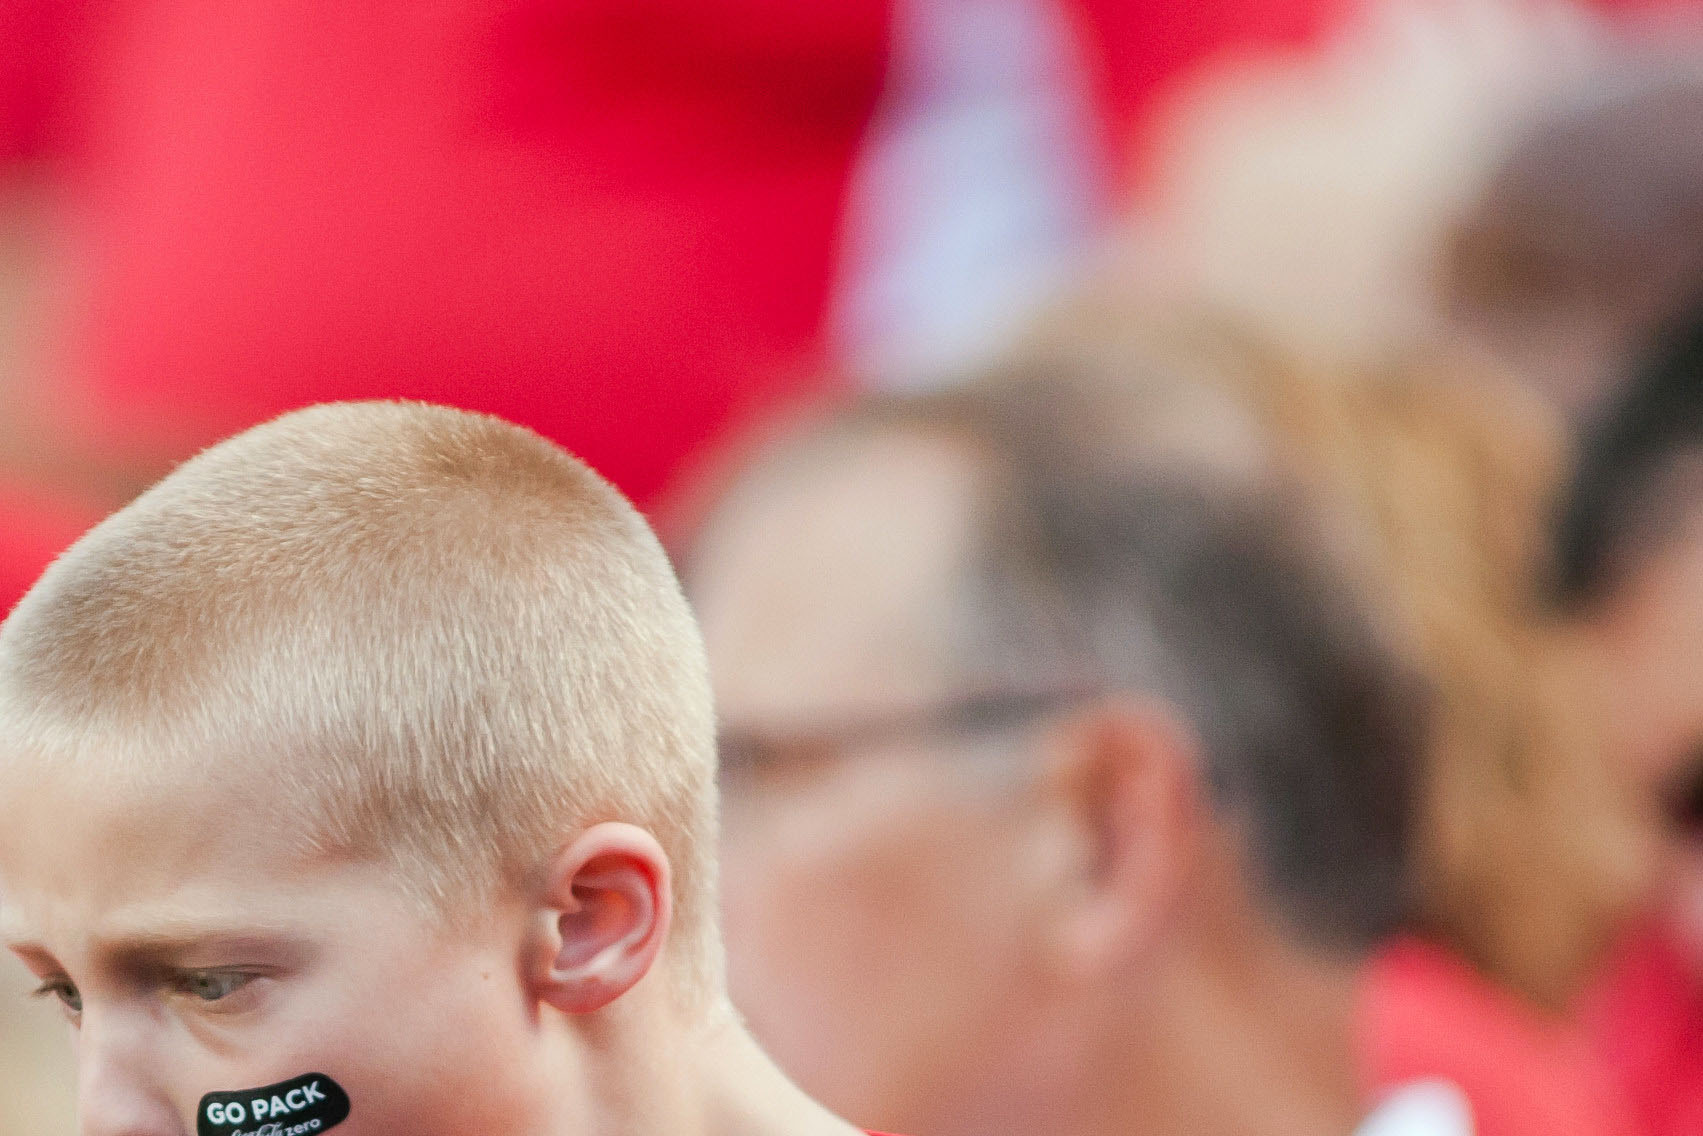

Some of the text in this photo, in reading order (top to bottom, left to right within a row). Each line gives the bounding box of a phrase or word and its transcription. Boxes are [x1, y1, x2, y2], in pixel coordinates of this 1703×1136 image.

[207, 1081, 326, 1124] GO PACK
[285, 1118, 320, 1136] zero
